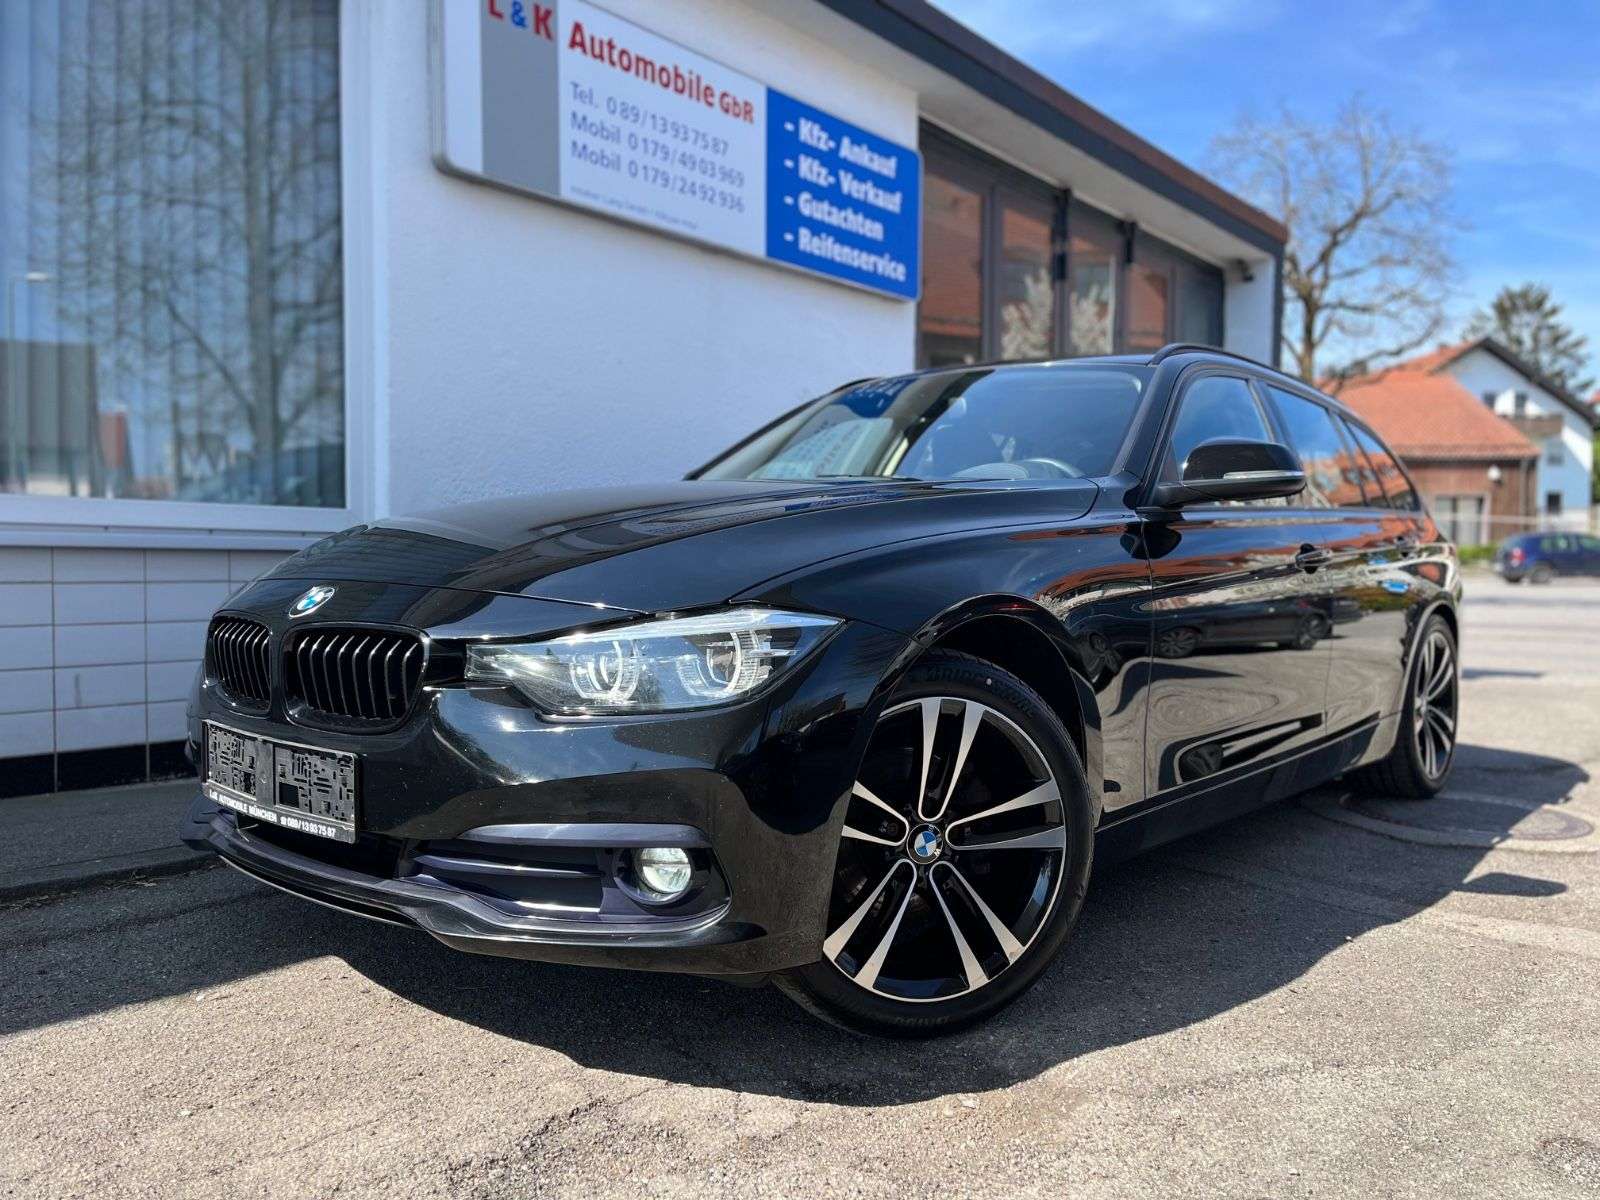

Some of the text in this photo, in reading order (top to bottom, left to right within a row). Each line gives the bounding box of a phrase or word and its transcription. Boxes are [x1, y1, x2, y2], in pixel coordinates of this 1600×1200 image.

[533, 3, 553, 41] K
[567, 21, 715, 108] Automobile
[719, 91, 755, 124] GbR
[570, 81, 599, 108] Tel.
[570, 110, 621, 144] Mobil
[570, 140, 621, 172] Mobil
[838, 136, 897, 179] Ankauf
[838, 170, 902, 214] Verkauf
[798, 191, 884, 241] Gutachten
[798, 226, 906, 283] Reifenservice
[219, 794, 248, 813] AUTOMOBILE
